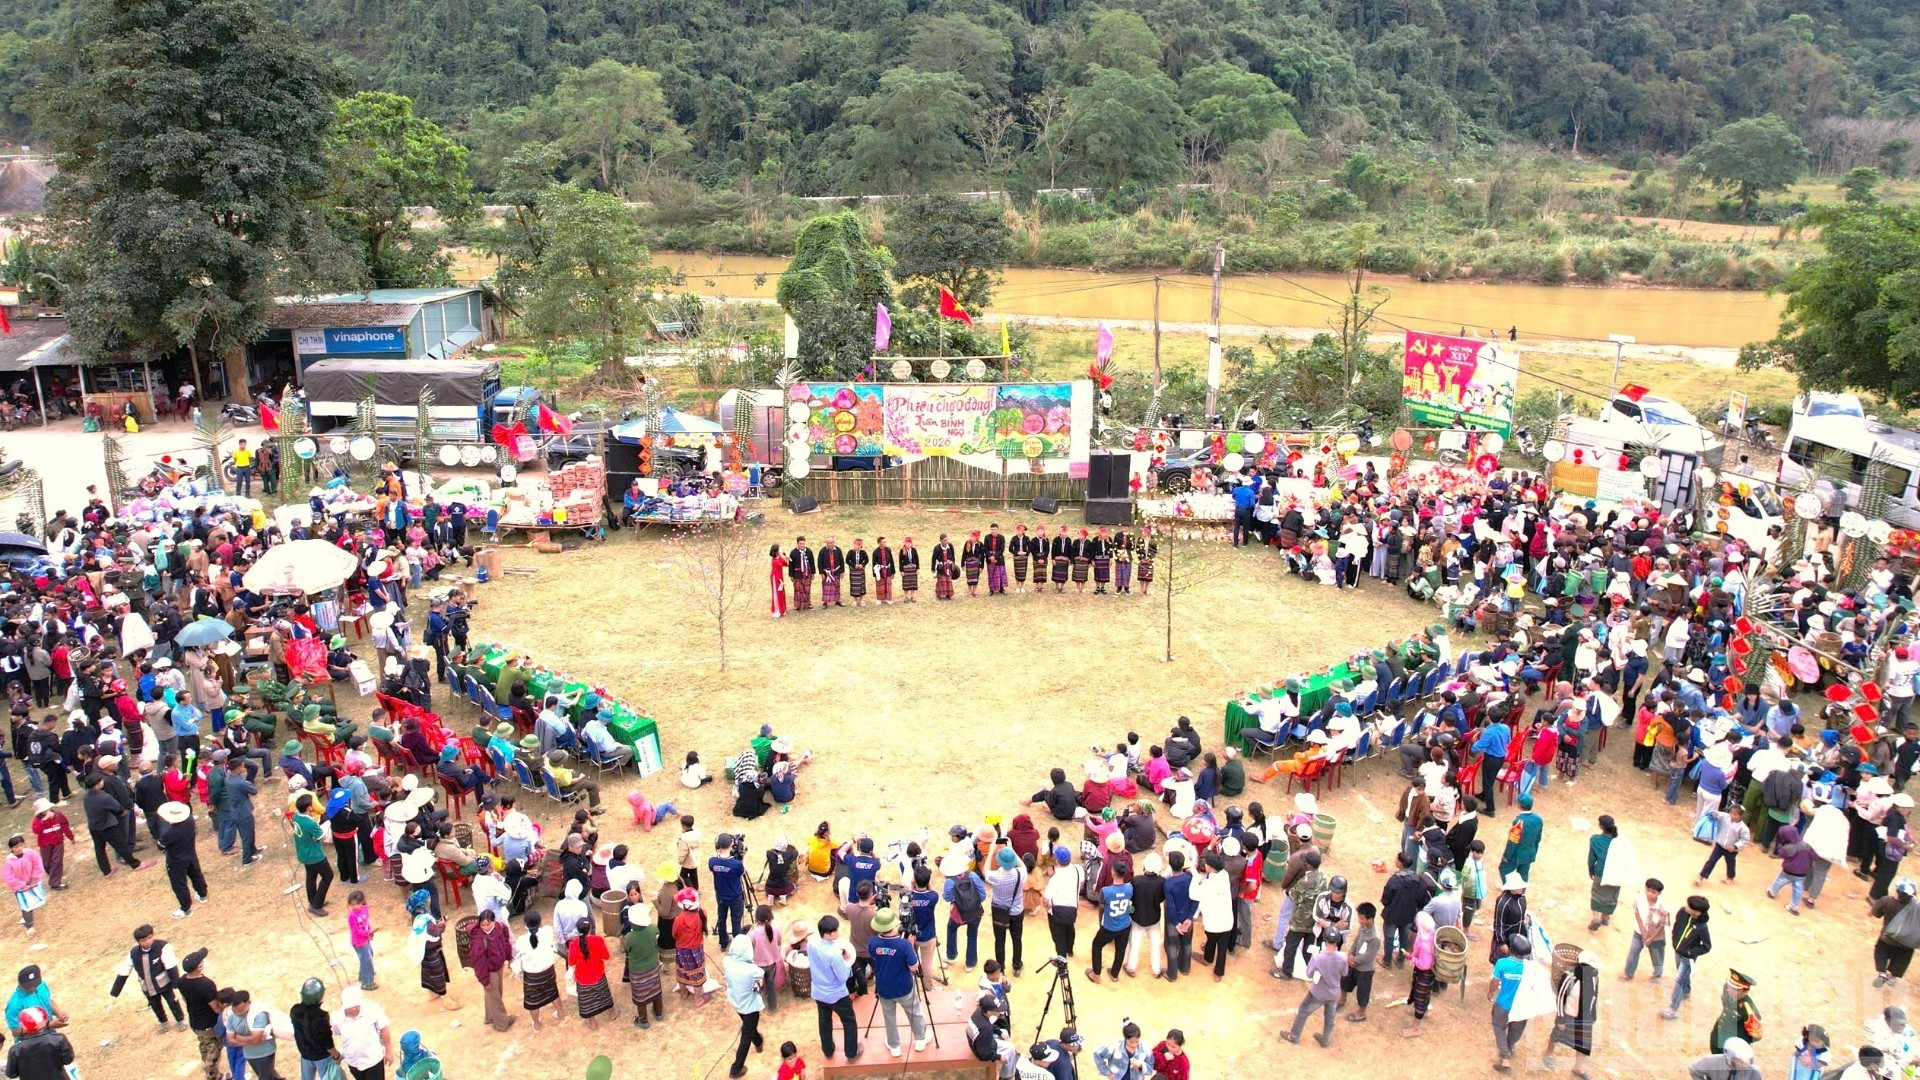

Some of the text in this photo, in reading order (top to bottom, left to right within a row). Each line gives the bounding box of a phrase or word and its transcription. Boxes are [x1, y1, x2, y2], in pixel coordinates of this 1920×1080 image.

[333, 331, 395, 343] vinaphone
[1451, 352, 1470, 362] XIV
[925, 437, 951, 447] 2026
[1109, 898, 1129, 917] 59
